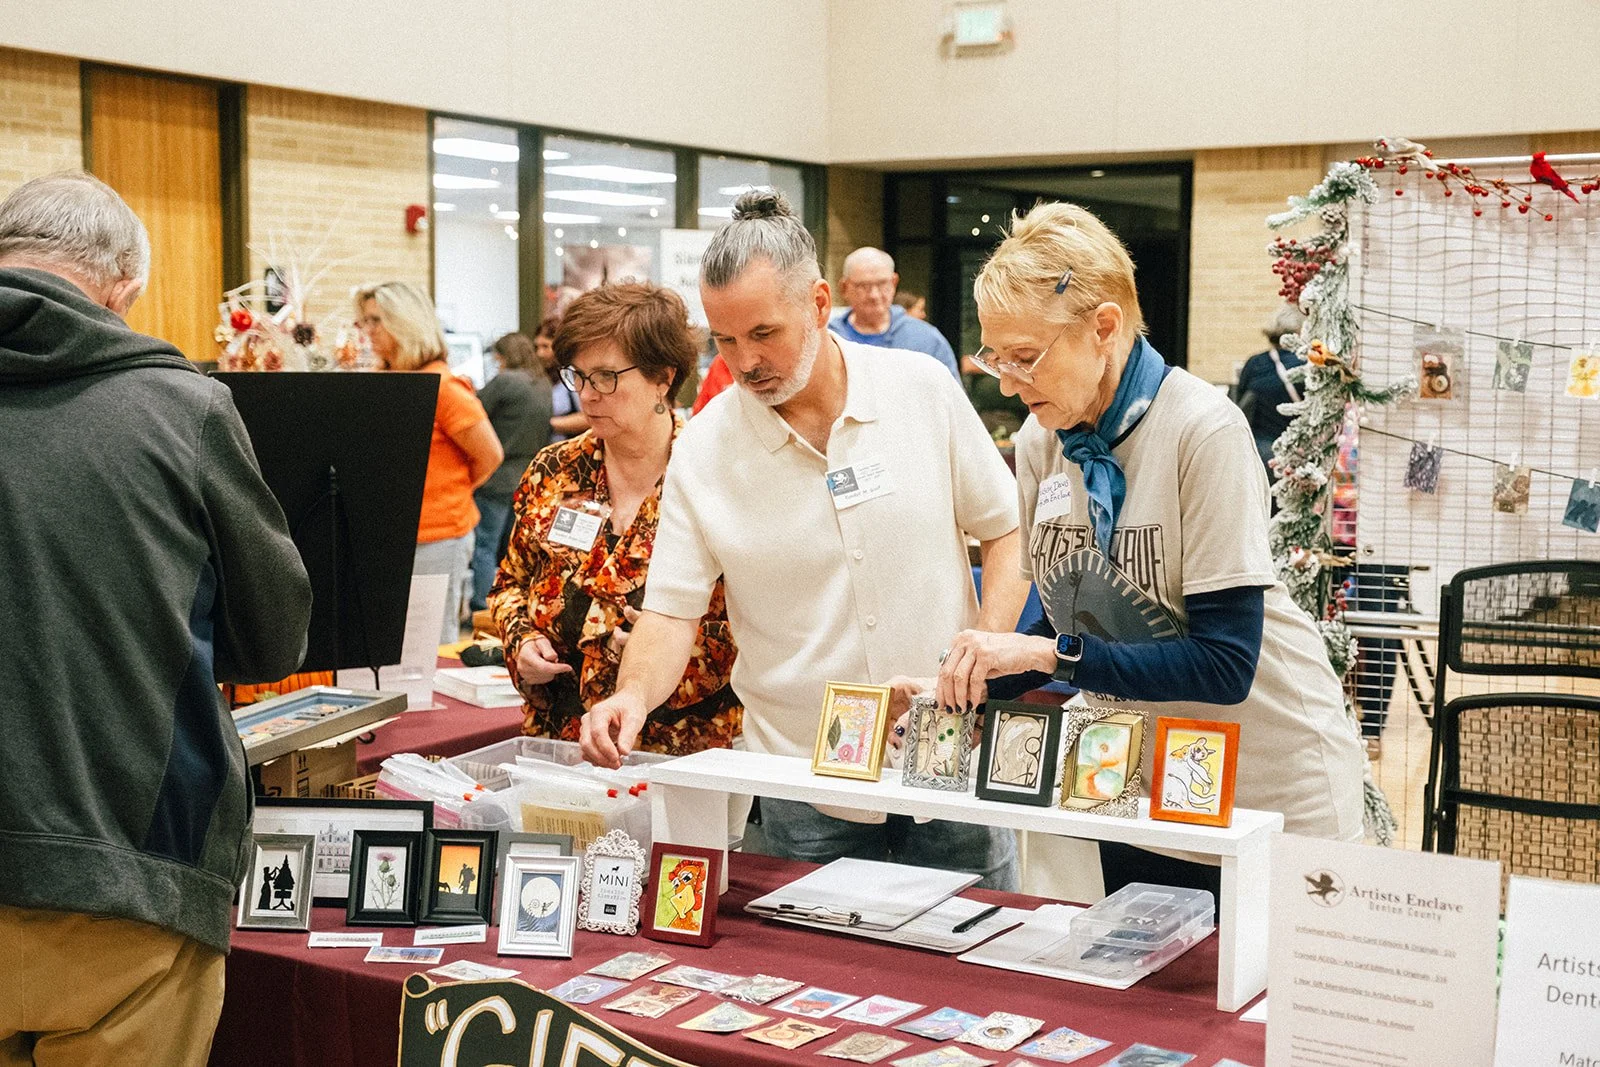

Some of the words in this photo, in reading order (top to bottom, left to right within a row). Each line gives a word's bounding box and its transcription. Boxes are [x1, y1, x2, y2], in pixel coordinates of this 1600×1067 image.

[598, 873, 629, 887] MINI
[1350, 885, 1400, 903] Artists
[1407, 893, 1464, 913] Enclave
[1369, 901, 1402, 915] Denton
[1407, 906, 1442, 922] County
[1546, 984, 1600, 1009] Dent
